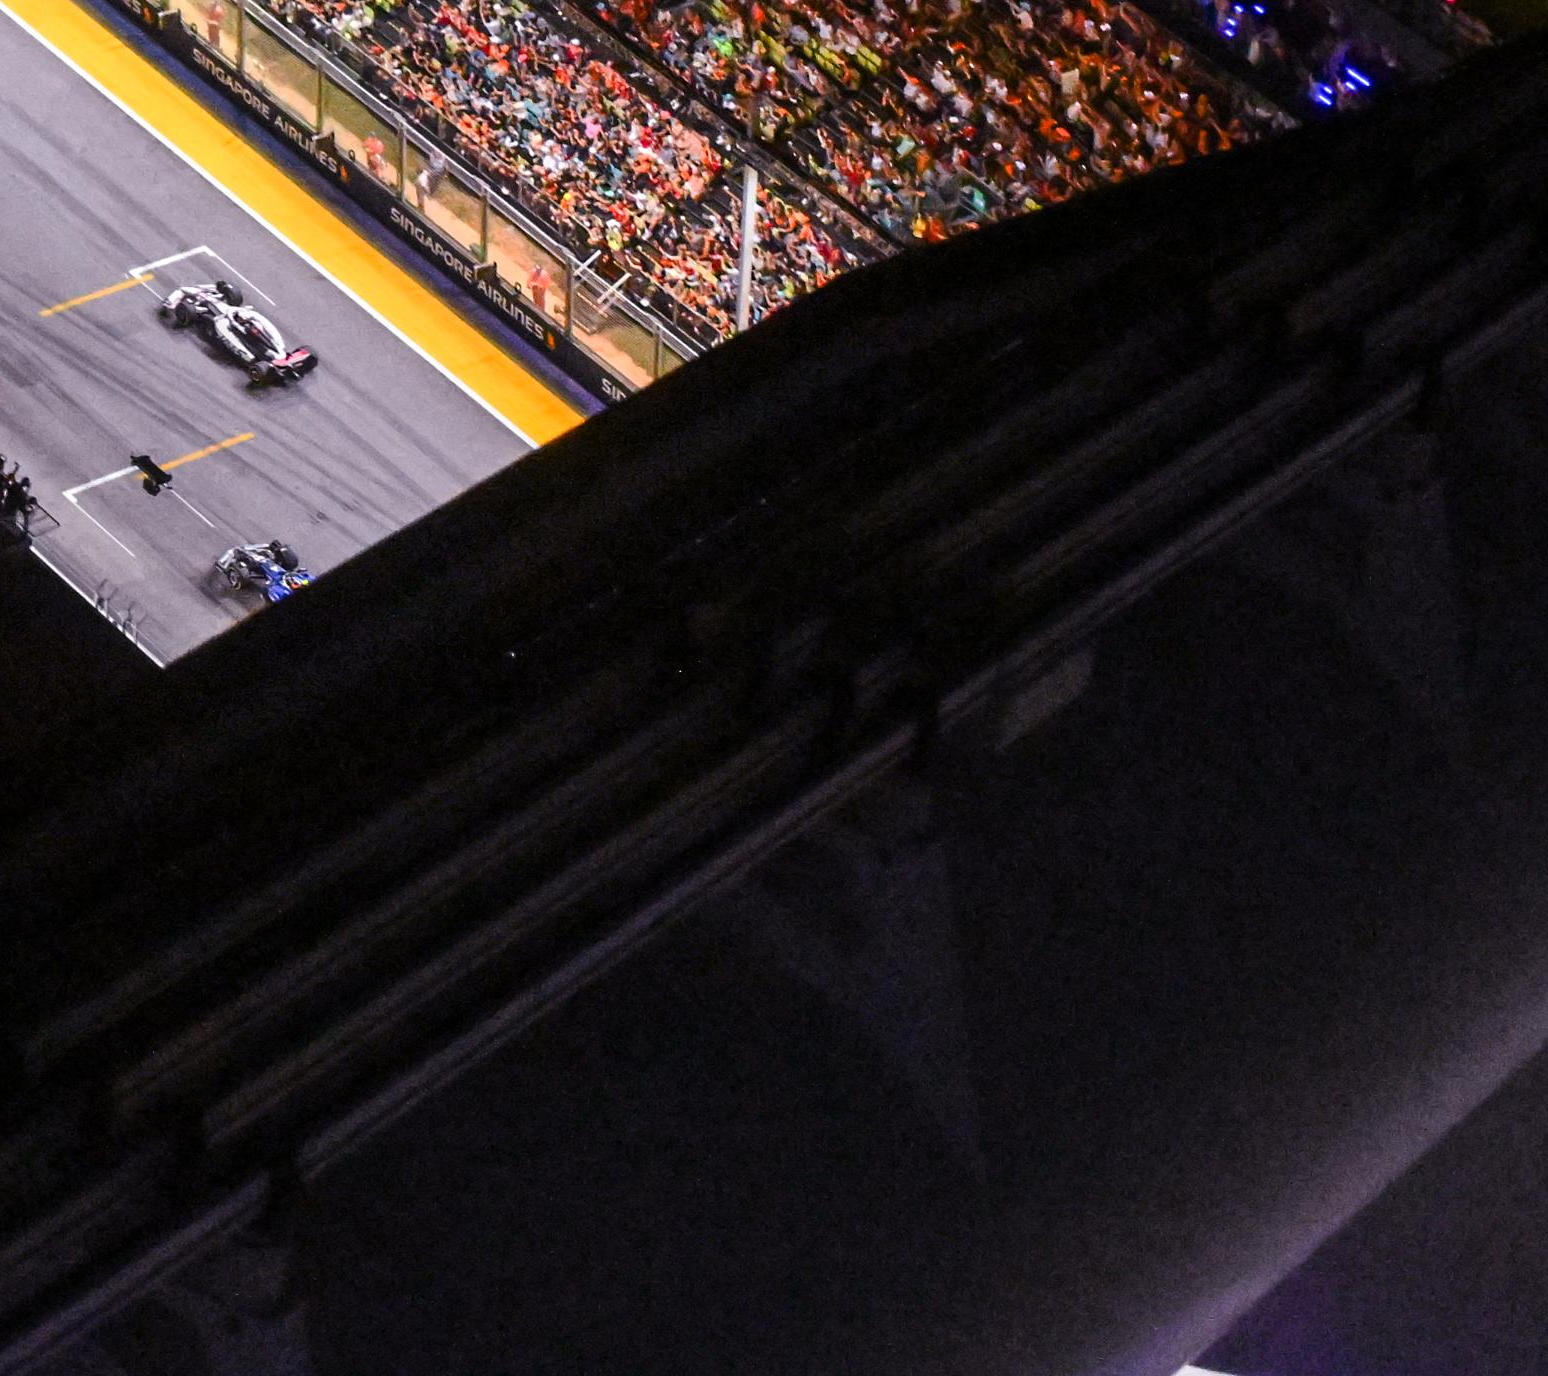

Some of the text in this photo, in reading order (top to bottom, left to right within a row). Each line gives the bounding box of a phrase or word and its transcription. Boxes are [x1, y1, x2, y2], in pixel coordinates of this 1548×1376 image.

[192, 47, 271, 119] SINGAPORE
[390, 207, 545, 342] SINGAPORE AIRLINES
